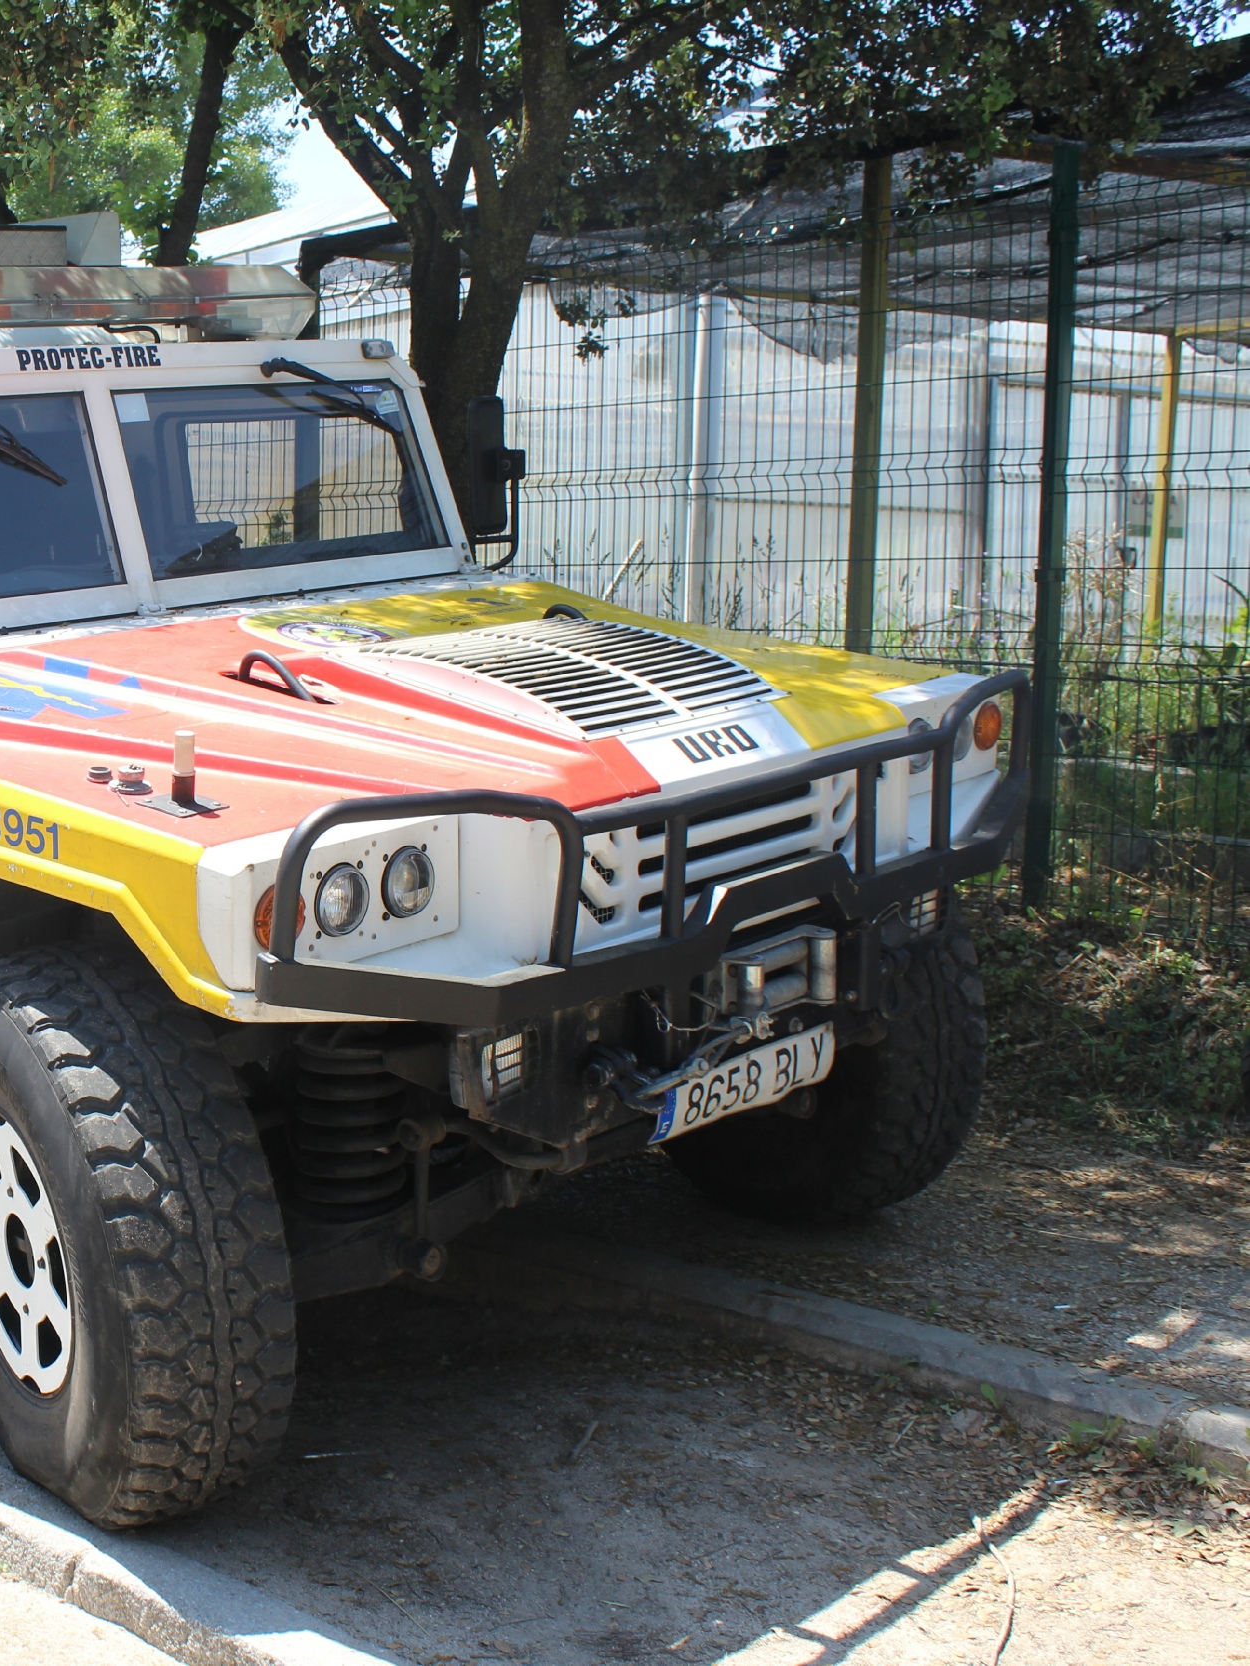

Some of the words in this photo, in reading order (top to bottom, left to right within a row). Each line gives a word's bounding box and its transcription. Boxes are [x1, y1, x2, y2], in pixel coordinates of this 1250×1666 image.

[16, 345, 161, 371] PROTEC-FIRE
[672, 724, 760, 763] URO
[684, 1059, 762, 1126] 8658
[772, 1032, 824, 1095] BLY
[659, 1120, 670, 1134] E
